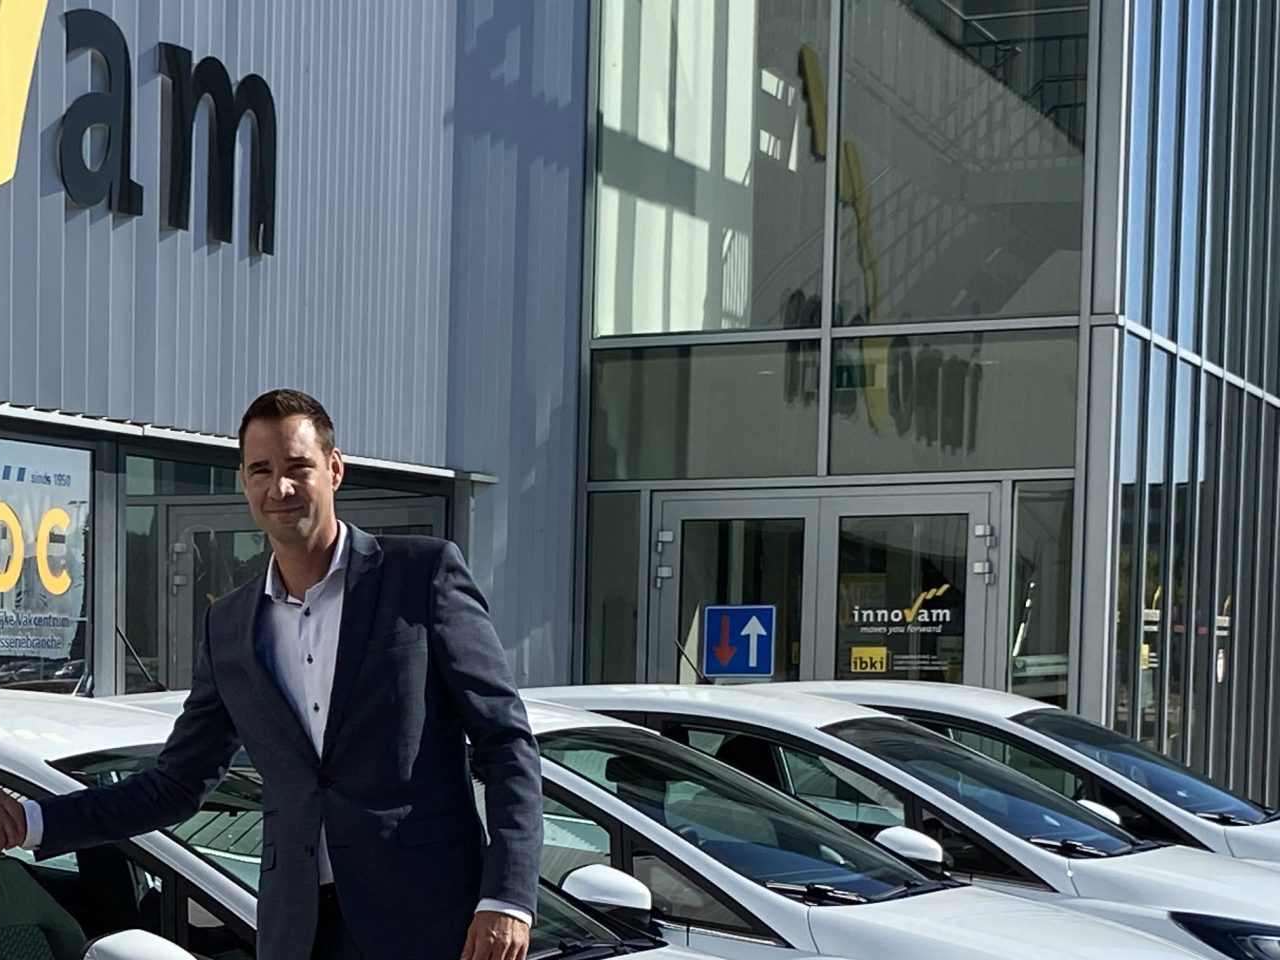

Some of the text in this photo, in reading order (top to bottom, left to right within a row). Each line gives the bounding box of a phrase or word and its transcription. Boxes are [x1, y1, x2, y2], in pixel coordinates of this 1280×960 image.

[852, 592, 951, 623] innovam
[860, 624, 942, 635] moves you forward
[852, 656, 884, 671] ibki
